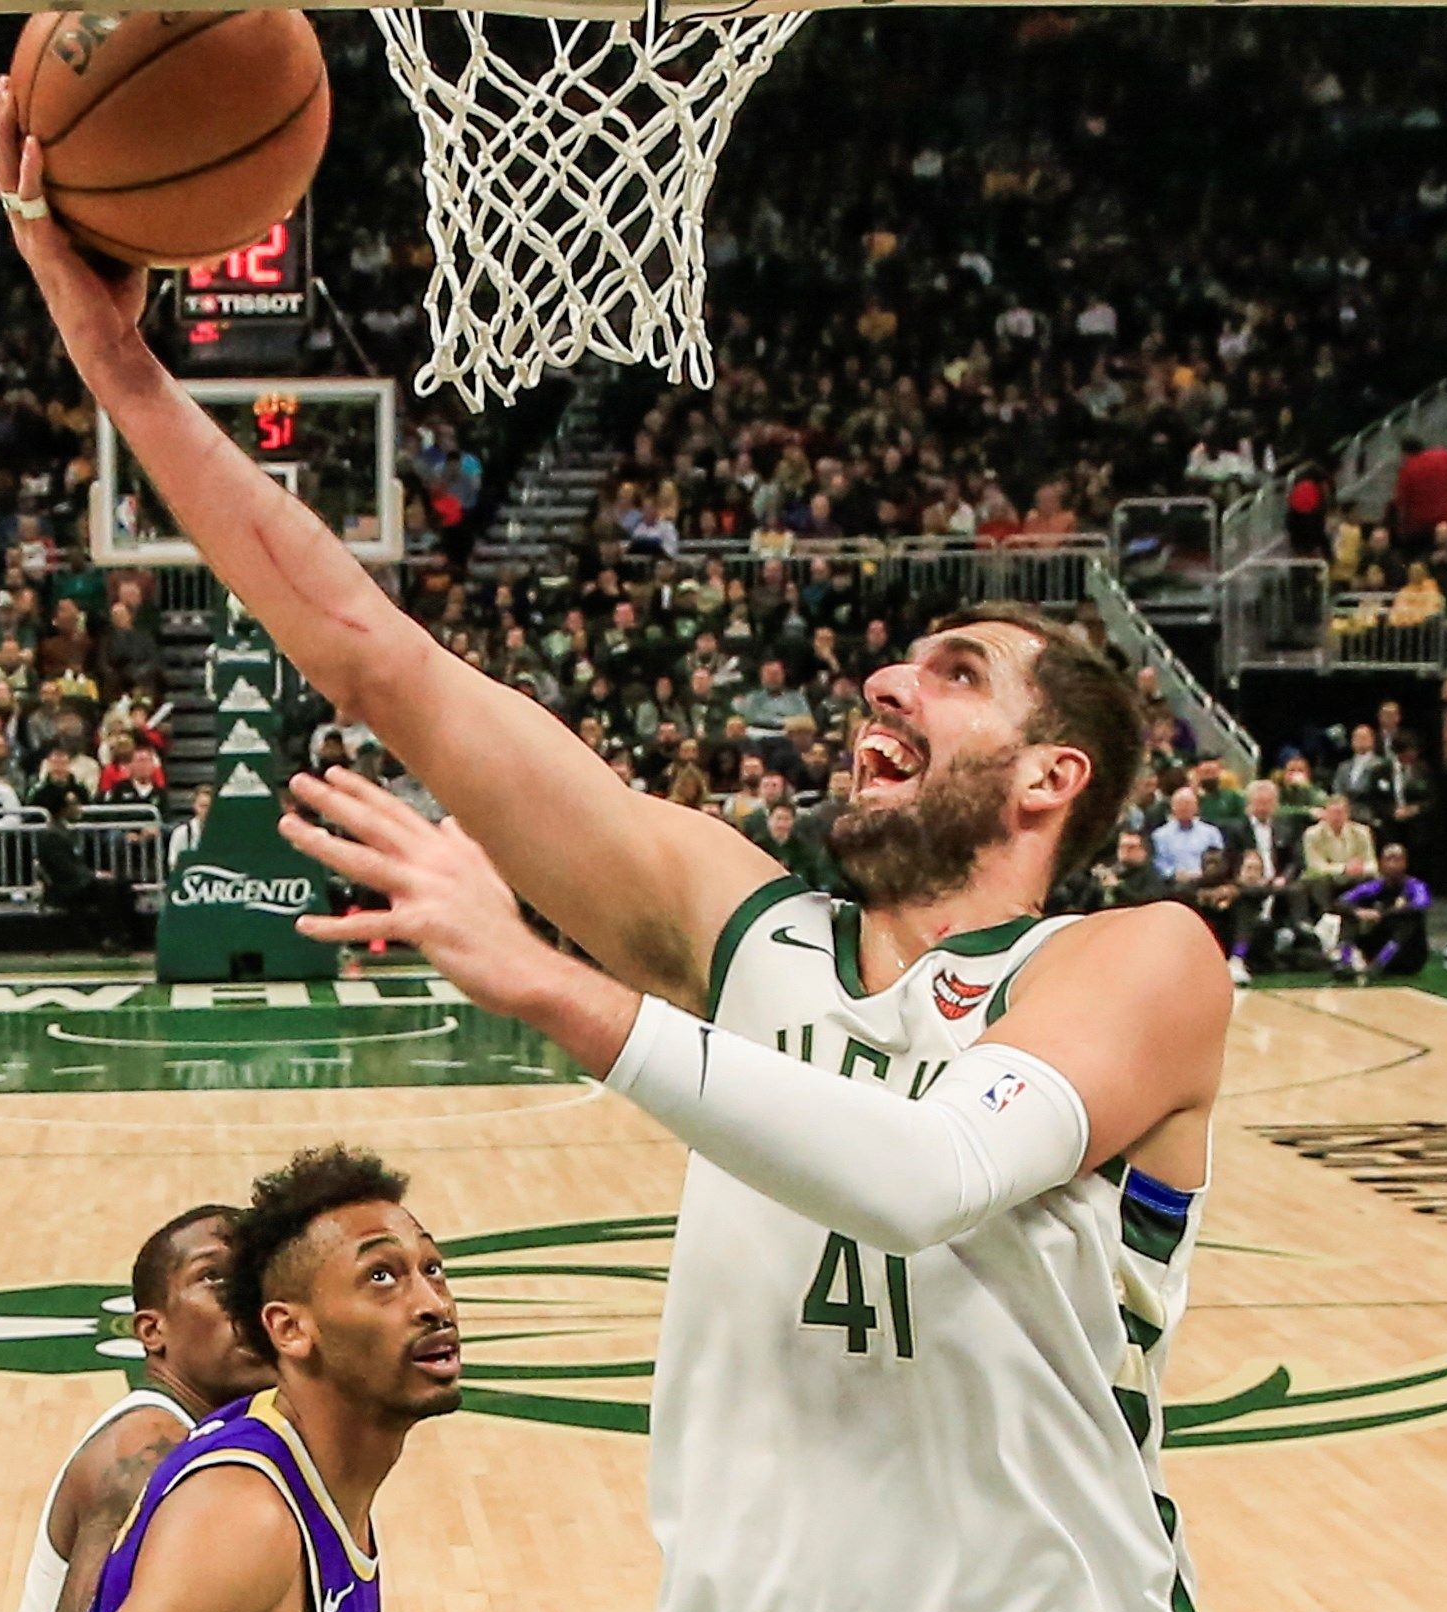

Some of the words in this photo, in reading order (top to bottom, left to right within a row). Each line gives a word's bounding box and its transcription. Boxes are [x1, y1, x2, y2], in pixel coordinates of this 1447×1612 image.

[218, 292, 303, 314] TISSOT
[171, 865, 314, 915] SARGENTO
[801, 1229, 915, 1360] 41
